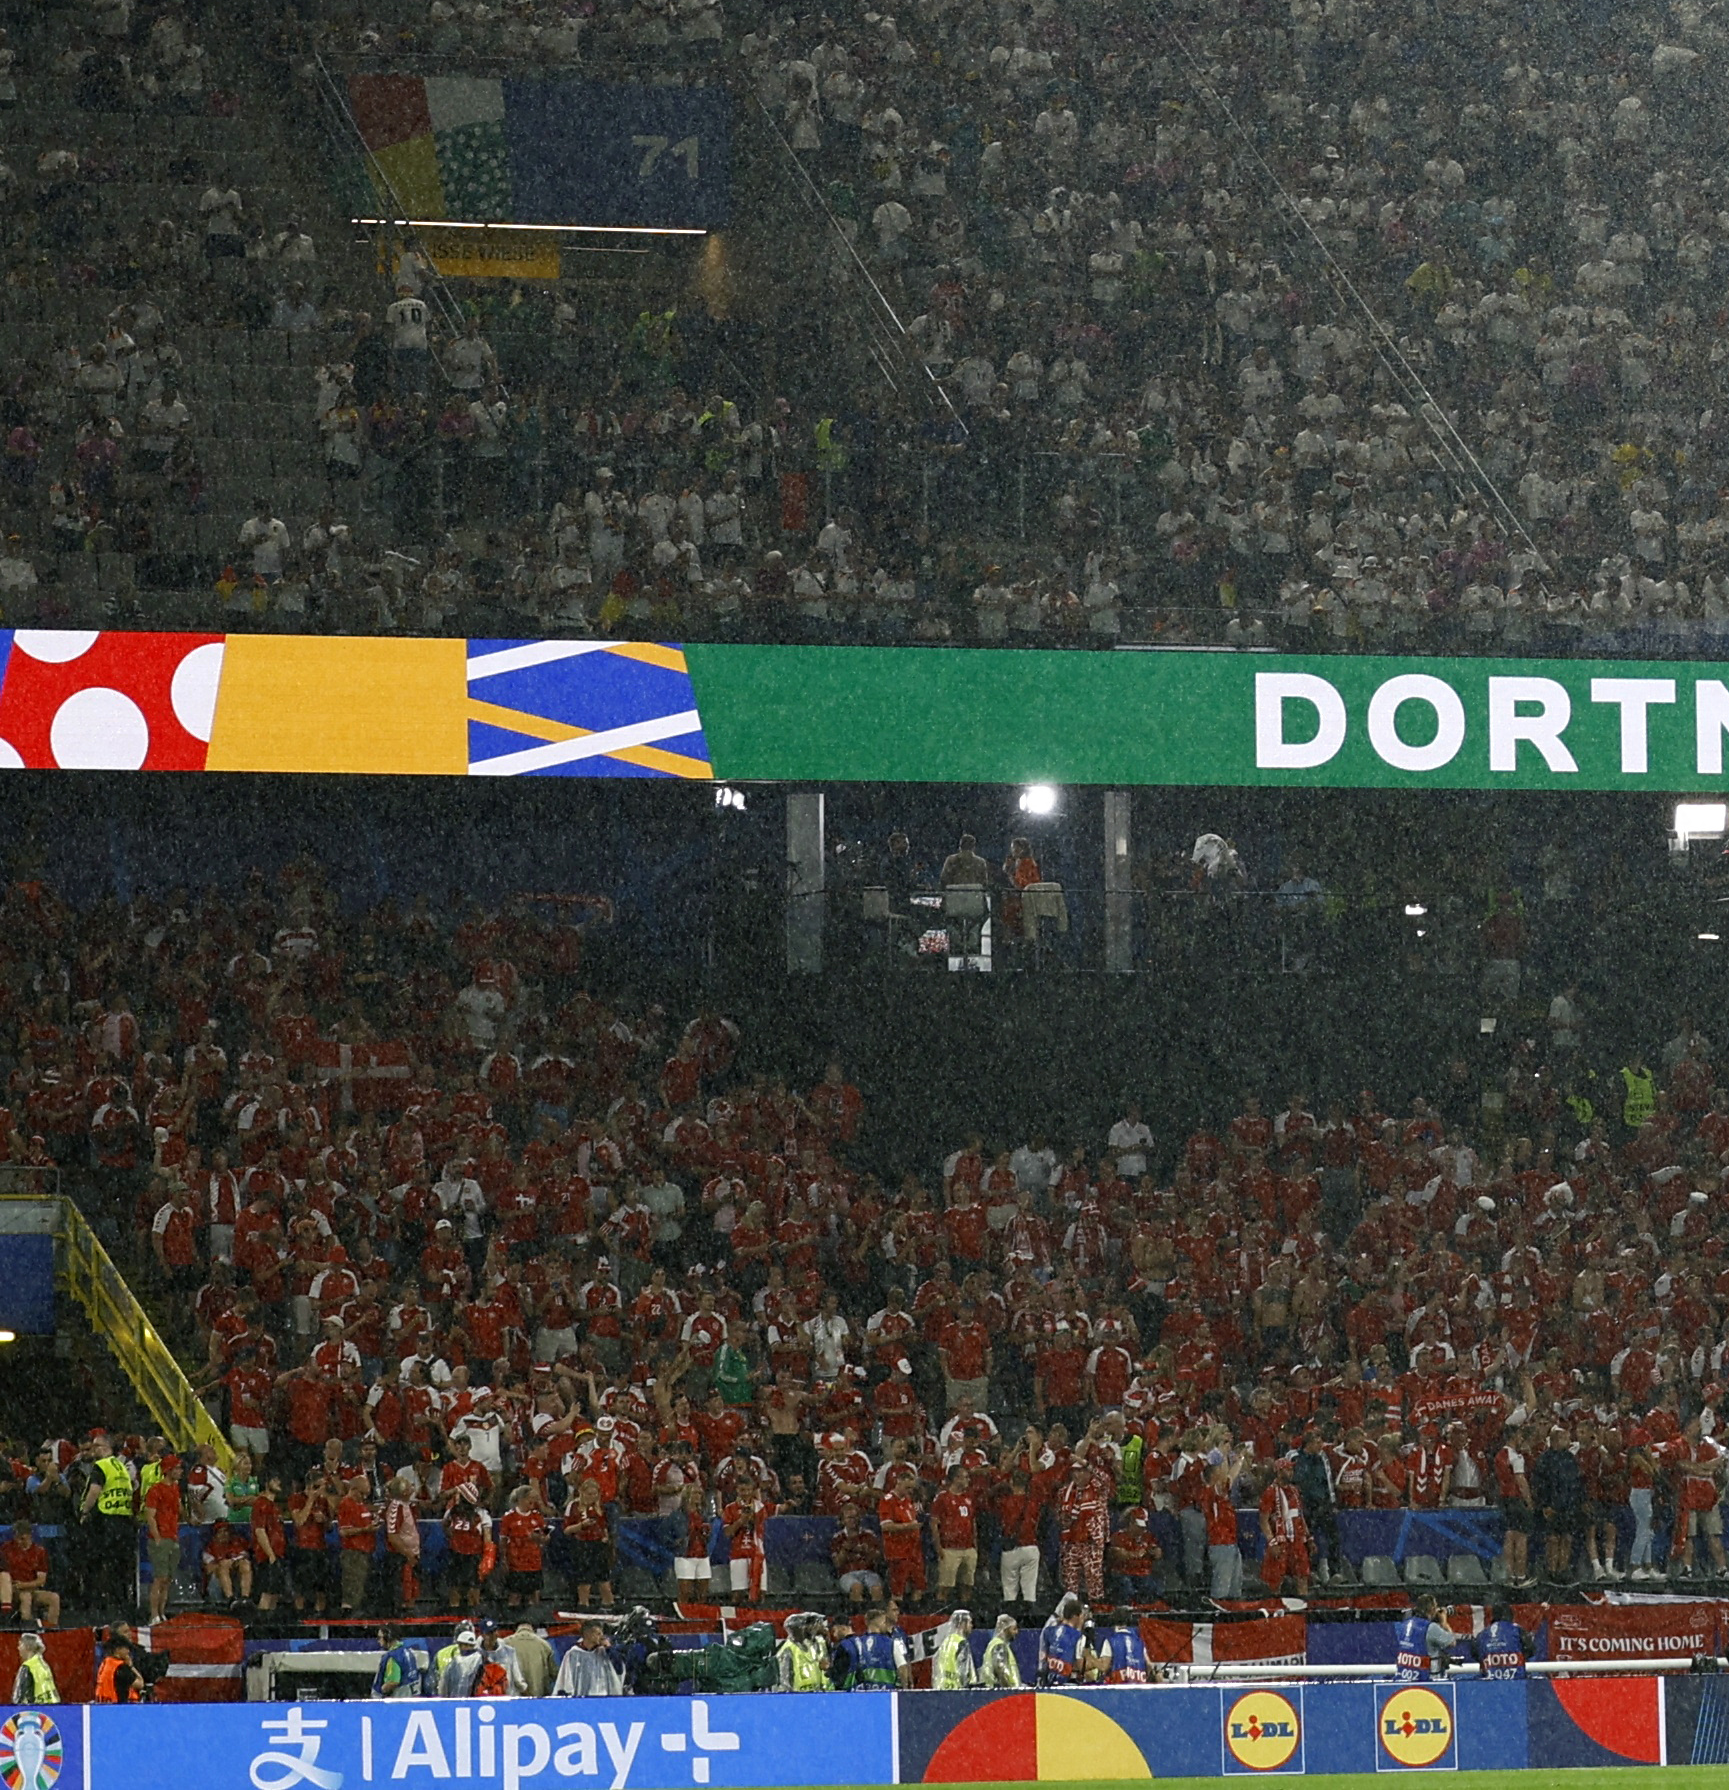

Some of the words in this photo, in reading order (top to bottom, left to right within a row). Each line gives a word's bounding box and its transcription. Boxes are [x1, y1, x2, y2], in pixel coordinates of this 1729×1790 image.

[631, 133, 700, 179] 71
[1426, 1398, 1465, 1411] DANES
[1467, 1394, 1500, 1406] AWAY
[1560, 1636, 1587, 1652] IT'S
[1589, 1636, 1654, 1652] COMING
[1658, 1634, 1704, 1650] HOME
